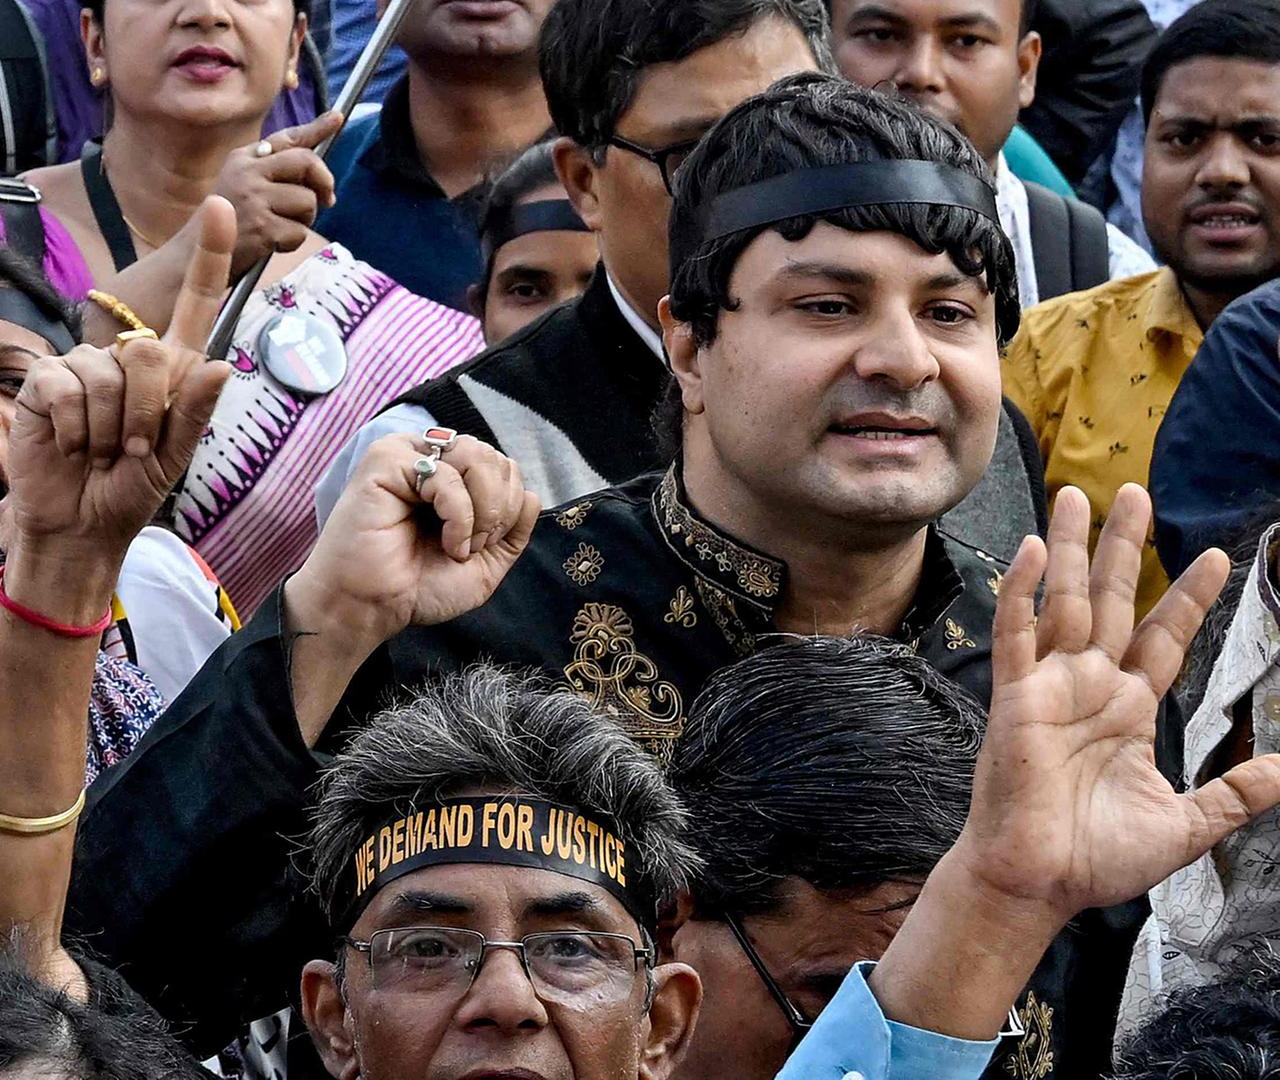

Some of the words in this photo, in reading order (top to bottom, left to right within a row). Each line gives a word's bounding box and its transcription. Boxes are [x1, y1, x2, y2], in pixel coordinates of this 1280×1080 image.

[355, 836, 375, 896] WE
[379, 804, 473, 872] DEMAND
[482, 803, 534, 852] FOR
[541, 808, 626, 887] JUSTICE
